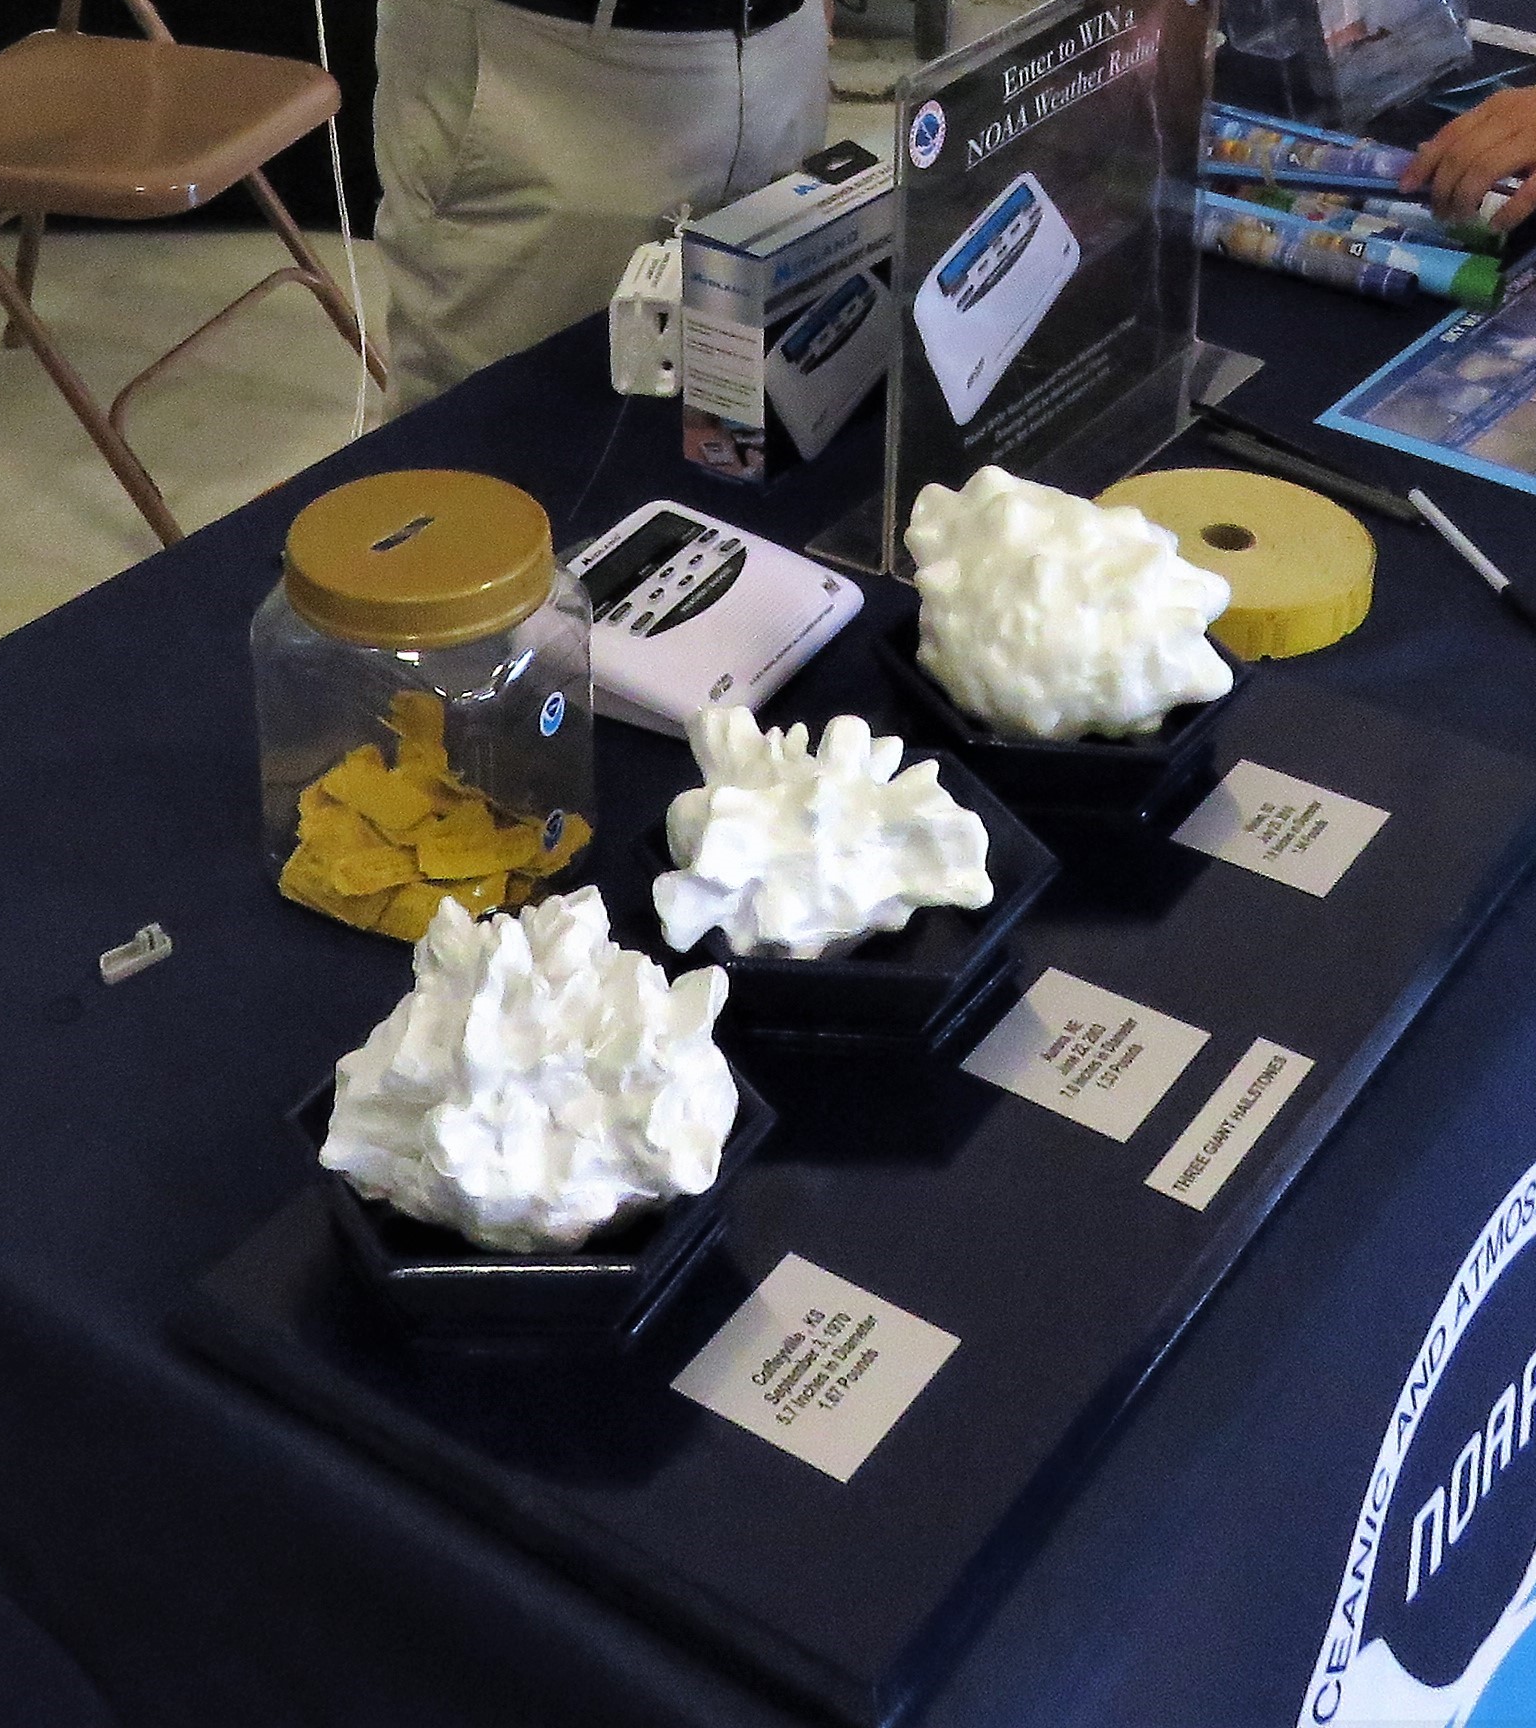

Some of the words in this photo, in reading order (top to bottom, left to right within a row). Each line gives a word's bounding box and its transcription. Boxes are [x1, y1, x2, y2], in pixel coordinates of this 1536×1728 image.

[967, 104, 1028, 165] NOAA
[1034, 67, 1105, 119] Weather
[1108, 28, 1161, 78] Radio!
[1002, 49, 1054, 98] Enter
[1058, 38, 1075, 61] to
[1078, 5, 1122, 48] WIN
[1172, 1152, 1211, 1193] THREE
[1202, 1119, 1237, 1155] GIANT
[1229, 1055, 1287, 1120] HAILSTONES
[763, 1347, 820, 1407] September
[822, 1311, 853, 1338] 1970
[790, 1371, 830, 1409] Inches
[820, 1360, 840, 1373] in
[830, 1313, 879, 1363] Diameter
[835, 1347, 880, 1390] Pounds
[1312, 1467, 1390, 1726] CEANIC
[1393, 1324, 1448, 1452] AND
